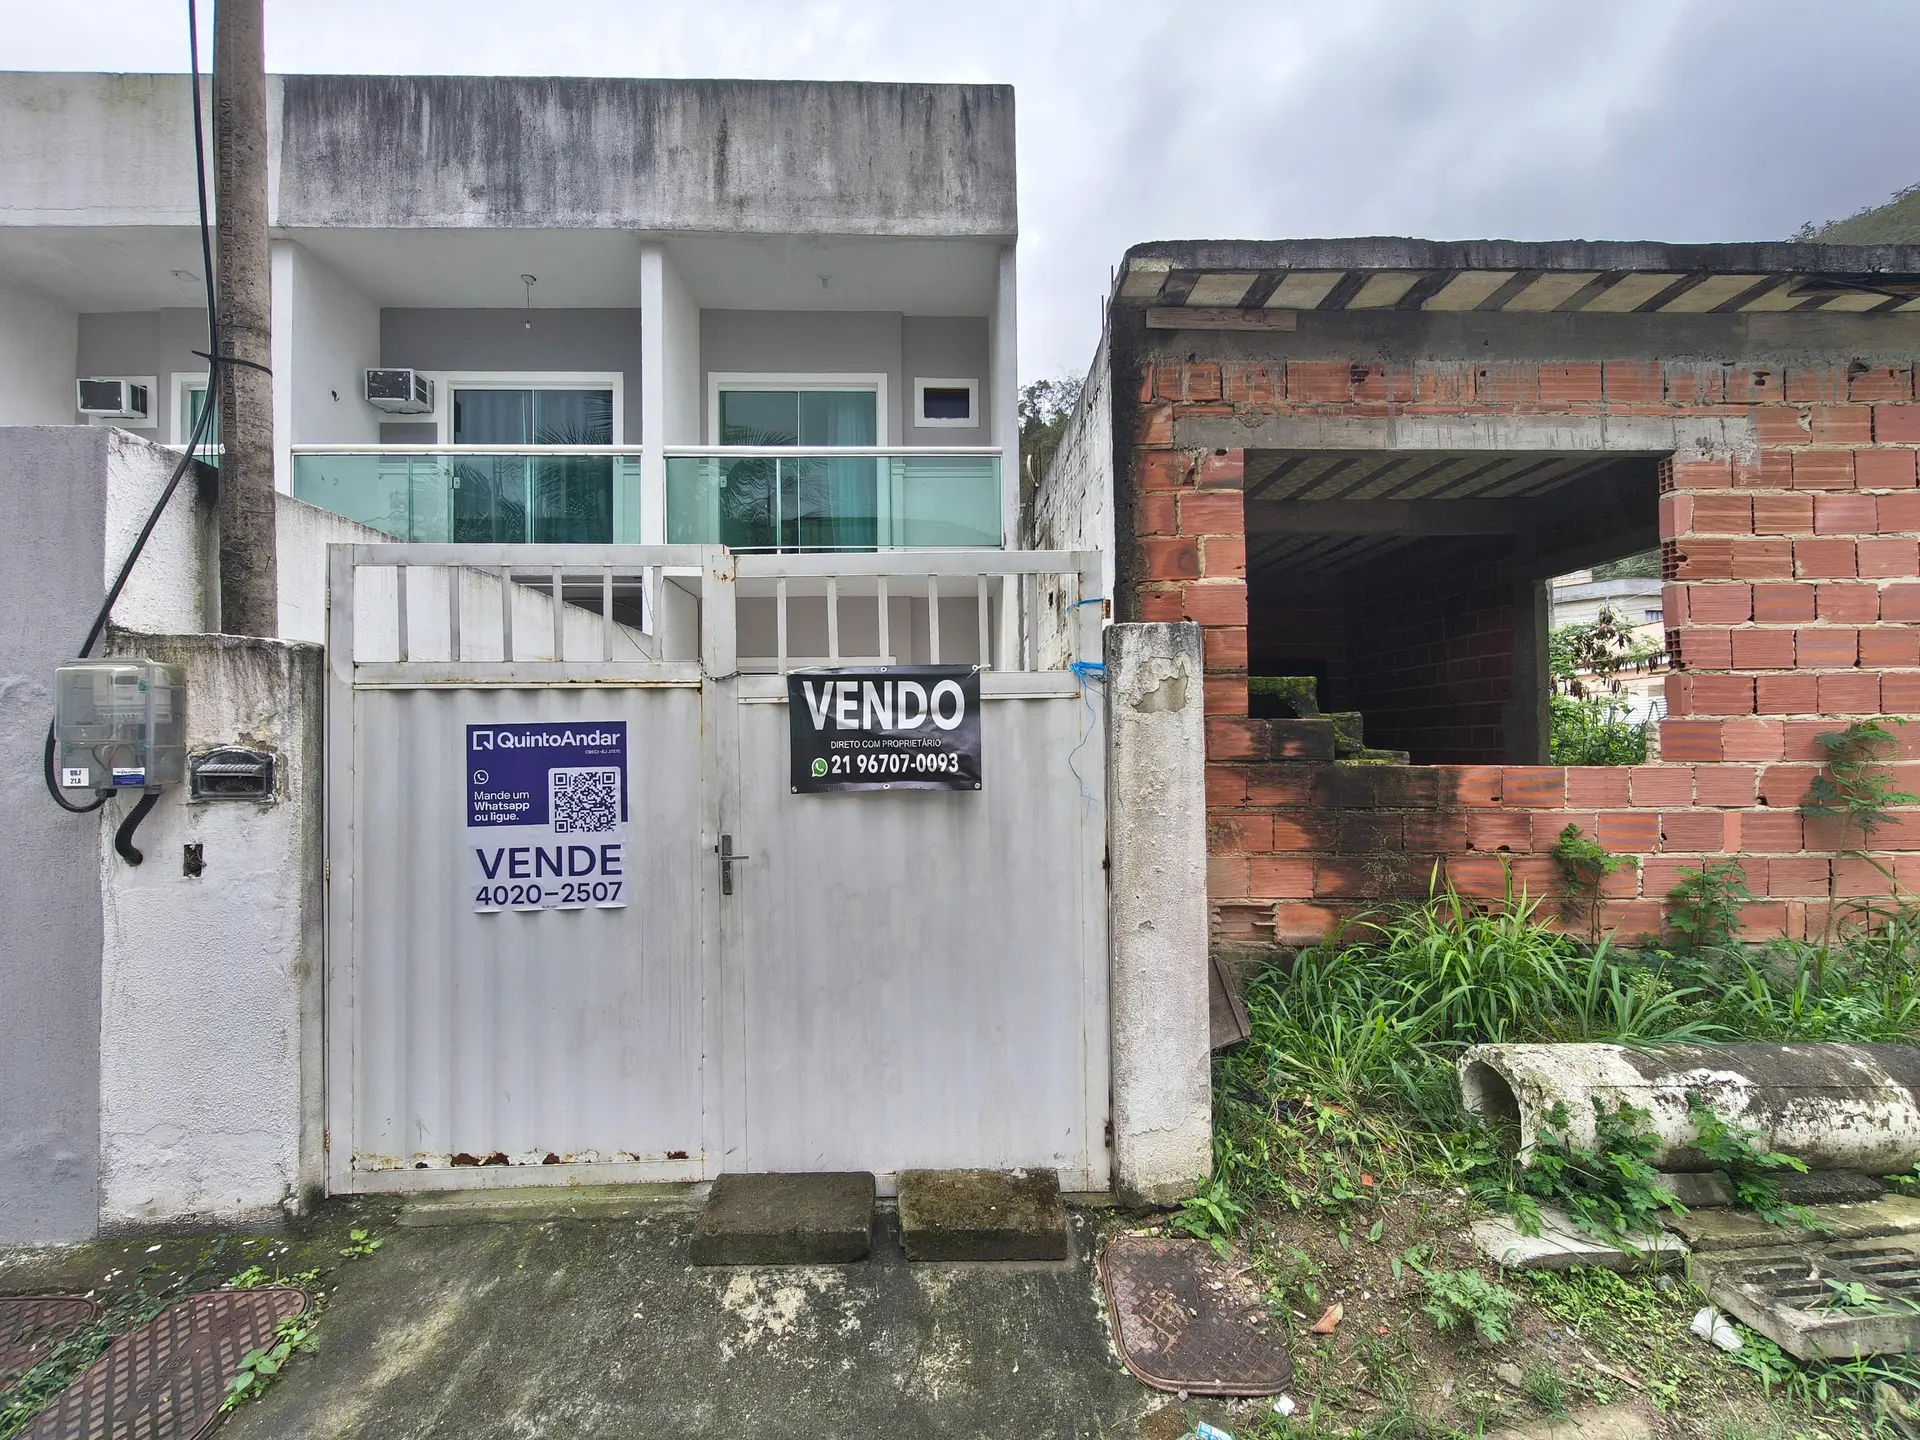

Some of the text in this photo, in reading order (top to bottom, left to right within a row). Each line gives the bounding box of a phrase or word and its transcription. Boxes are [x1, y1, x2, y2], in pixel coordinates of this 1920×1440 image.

[802, 679, 965, 731] VENDO
[497, 730, 620, 749] QuintoAndar
[830, 738, 941, 749] DIRETO COM PROPRIETÁRIO
[831, 752, 959, 774] 21 96707-0093
[474, 791, 530, 800] Mande um
[474, 800, 530, 812] Whatsapp
[474, 811, 519, 823] ou ligue.
[475, 844, 623, 880] VENDE
[475, 881, 623, 906] 4020-2507
